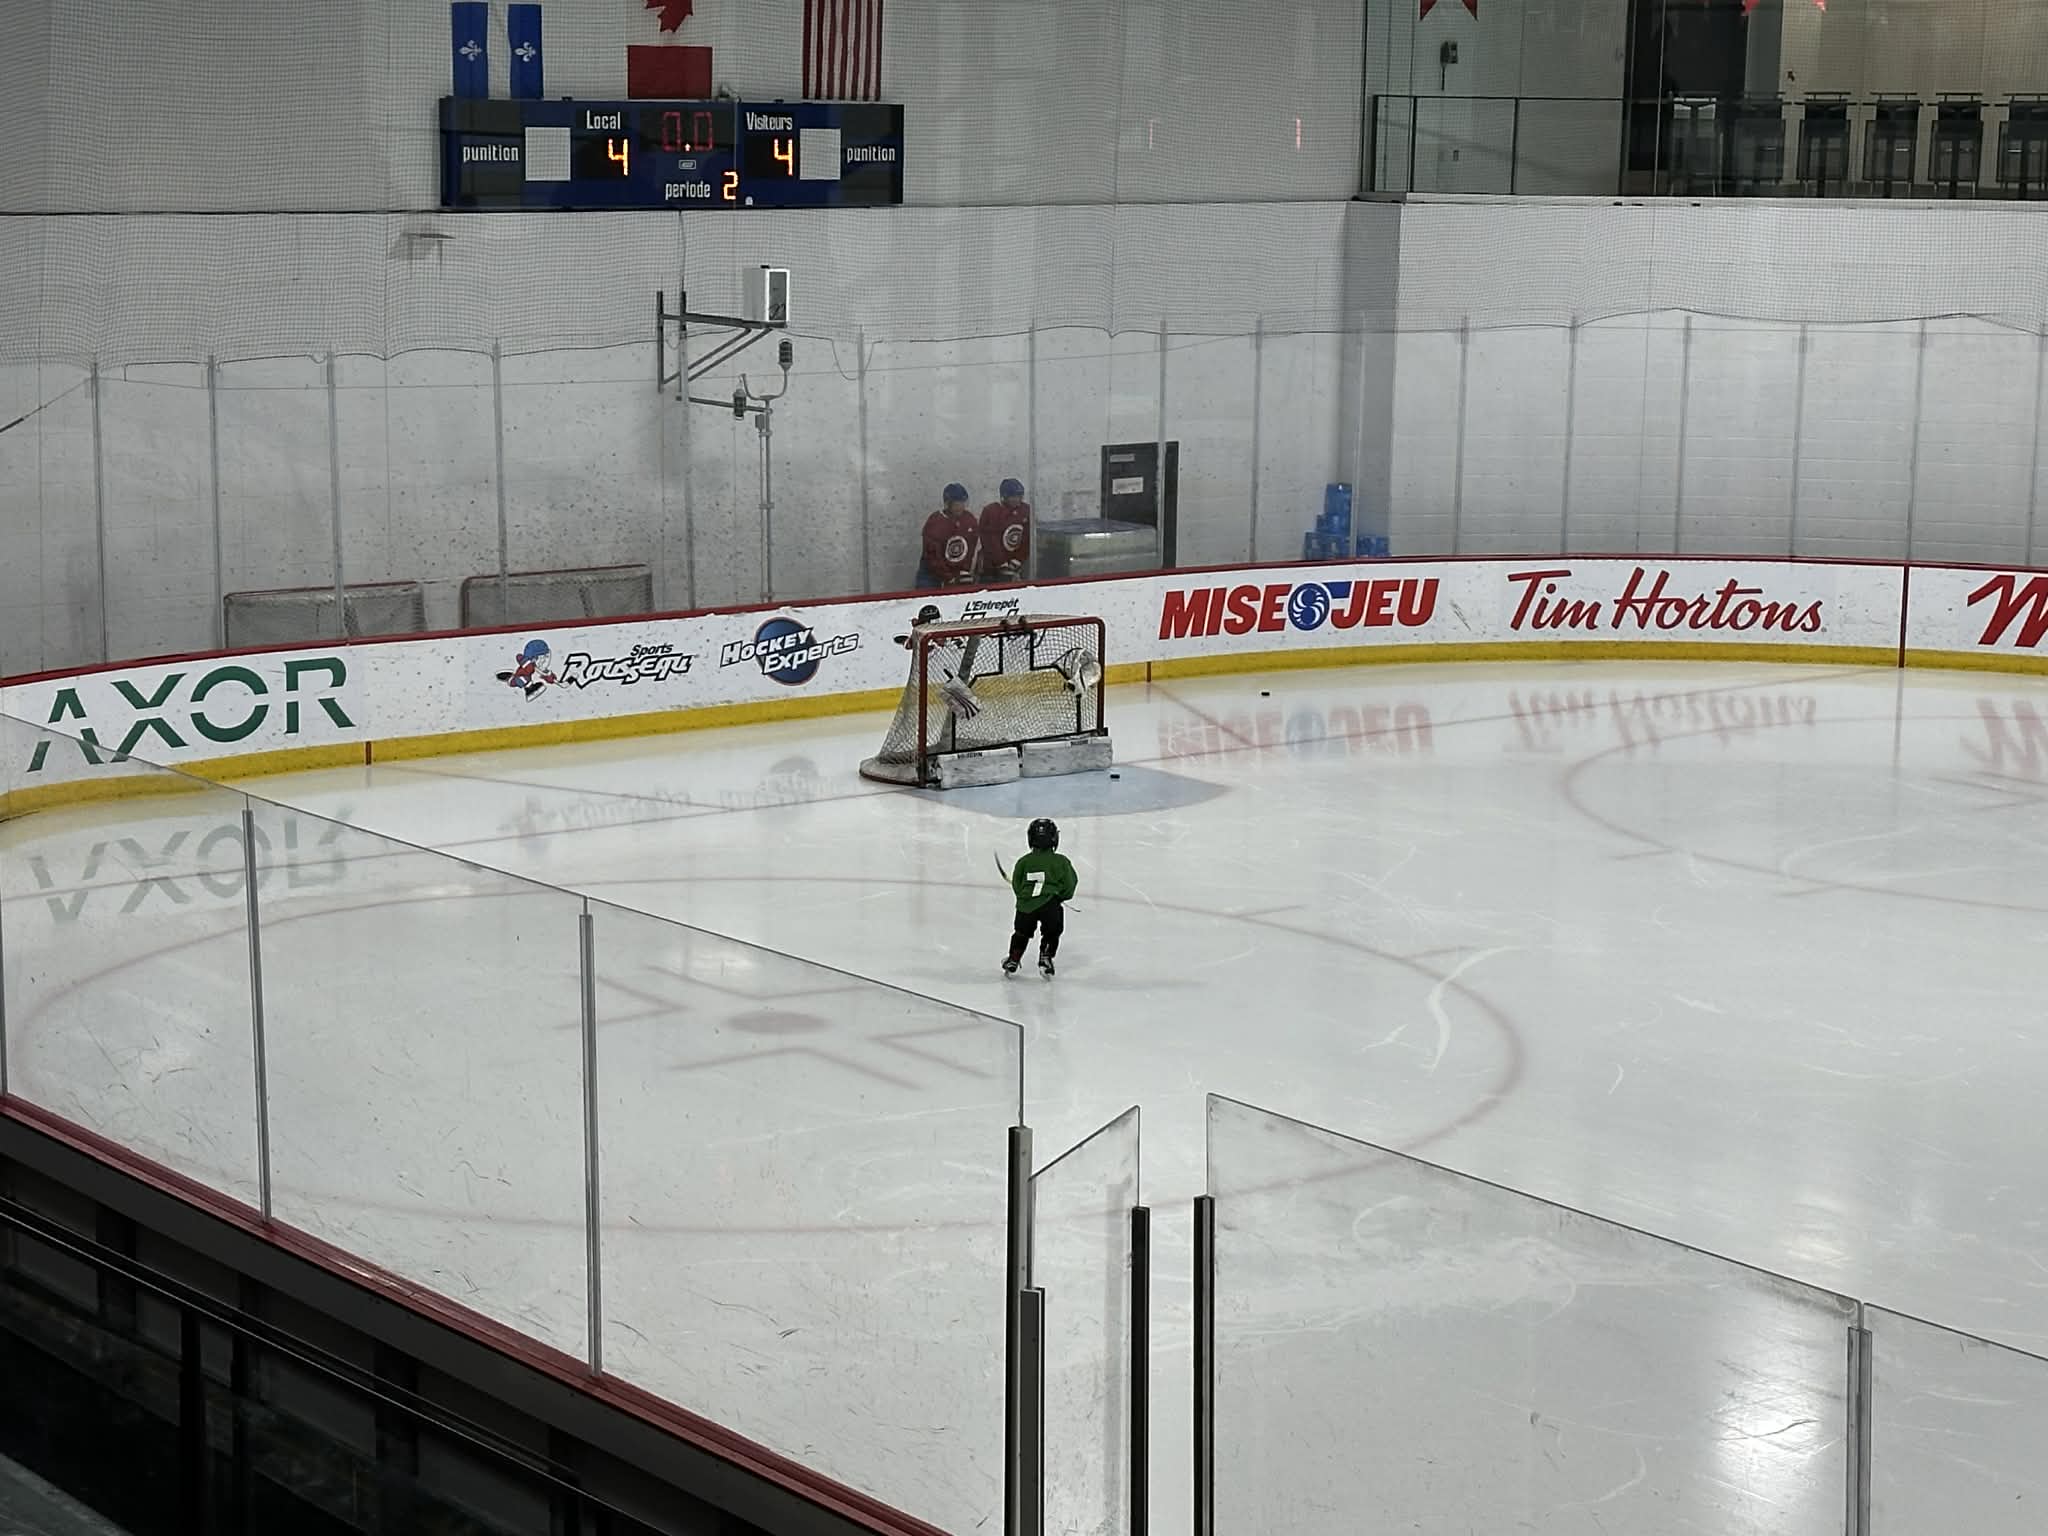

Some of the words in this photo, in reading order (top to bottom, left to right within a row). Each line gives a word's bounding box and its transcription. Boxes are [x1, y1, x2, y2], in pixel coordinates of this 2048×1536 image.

[586, 110, 621, 130] Local
[746, 111, 793, 131] Visiteurs
[463, 144, 519, 163] punition
[608, 138, 629, 176] 4
[774, 138, 793, 176] 4
[847, 145, 896, 163] punition
[722, 171, 739, 200] 2
[1507, 569, 1602, 631] Tim
[1611, 566, 1824, 633] Hortons
[630, 644, 674, 658] Sports
[26, 656, 356, 773] AXOR
[1026, 871, 1045, 897] 7
